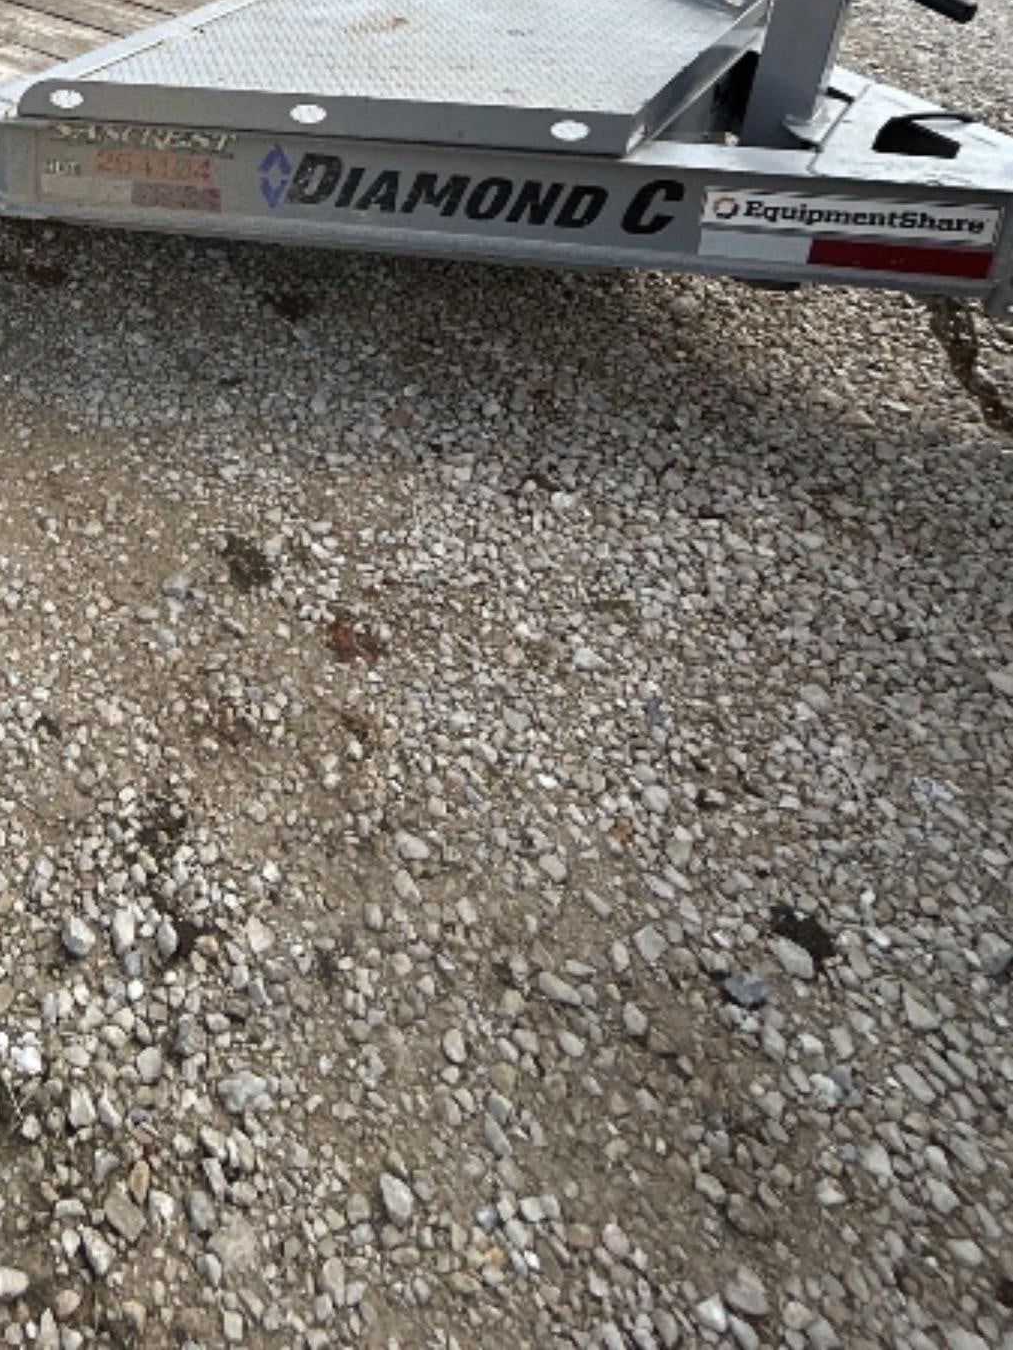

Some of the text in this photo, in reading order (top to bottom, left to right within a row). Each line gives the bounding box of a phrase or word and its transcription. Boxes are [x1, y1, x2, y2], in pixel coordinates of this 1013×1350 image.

[288, 152, 608, 229] DIAMOND
[620, 179, 685, 235] C
[743, 200, 987, 235] EquipmentShare
